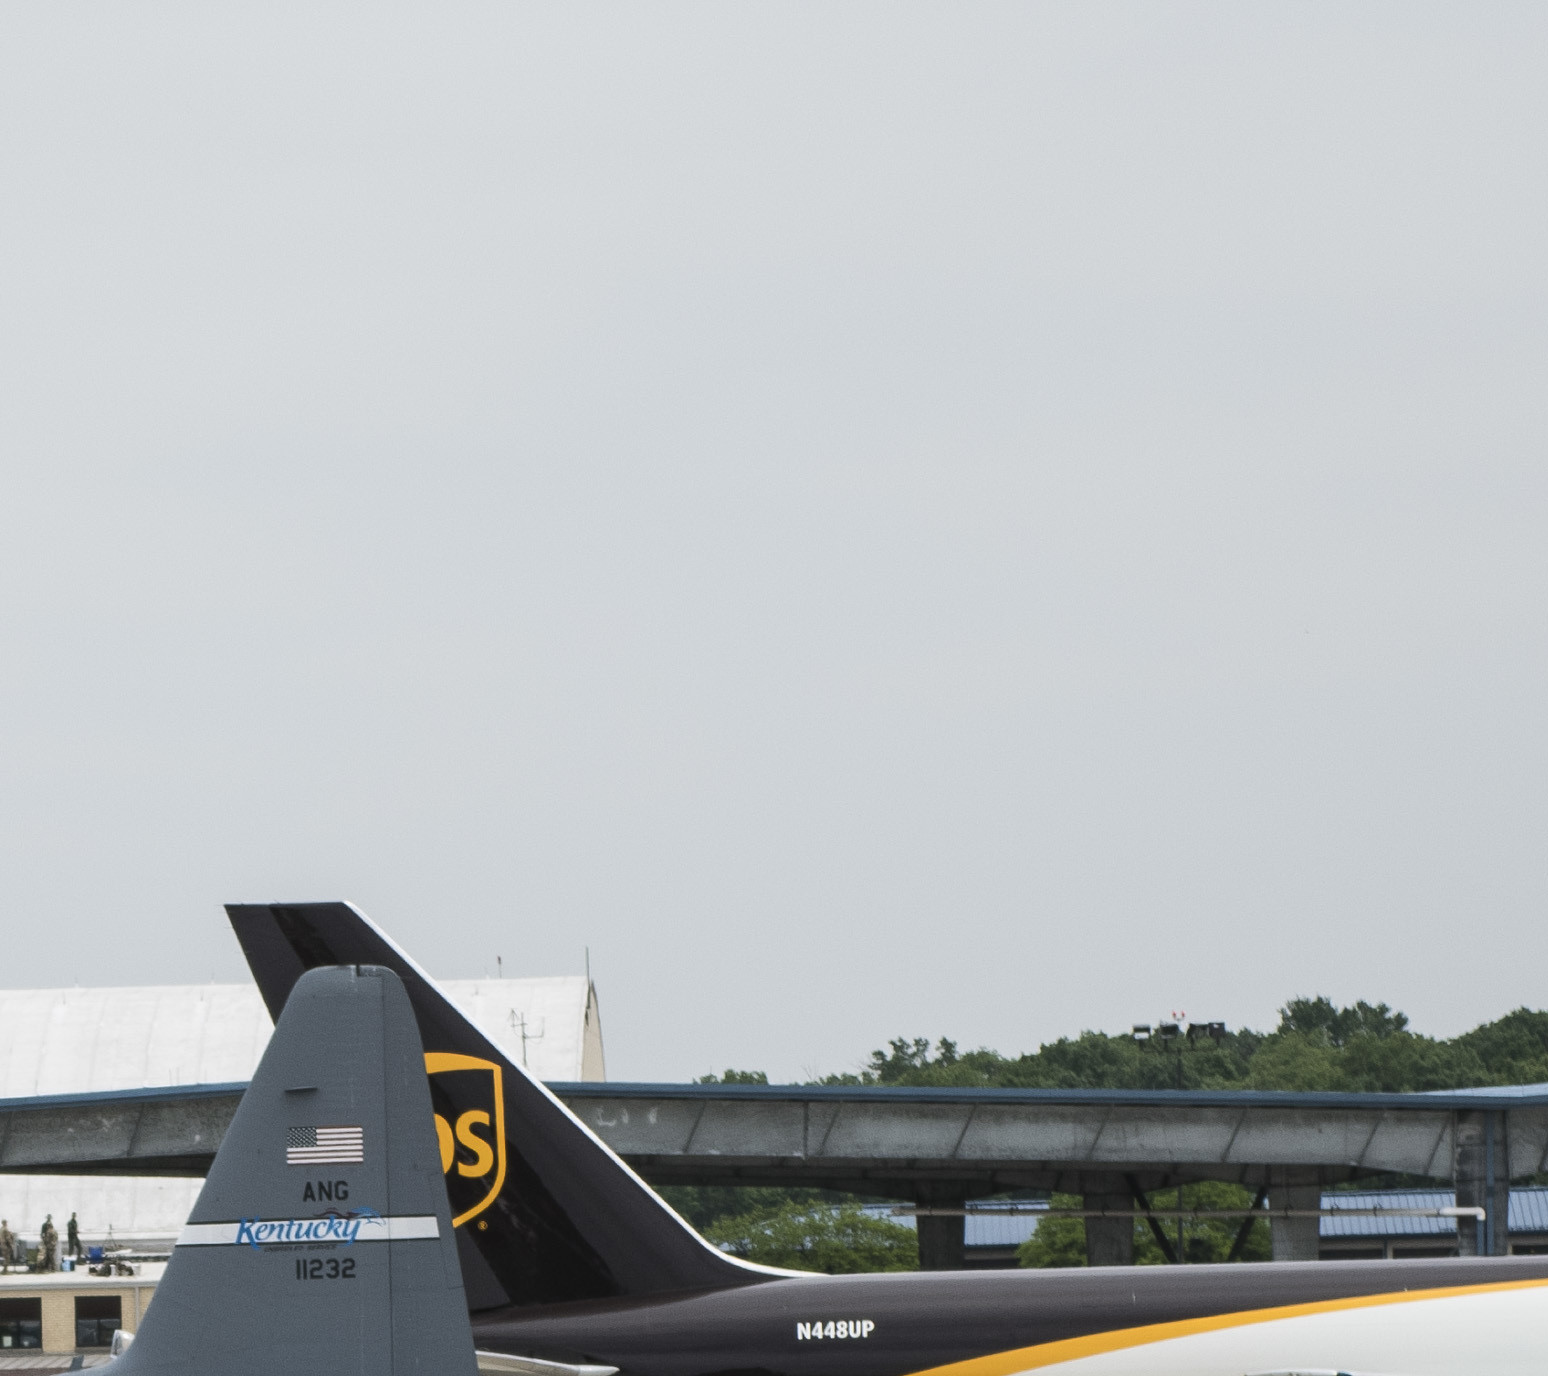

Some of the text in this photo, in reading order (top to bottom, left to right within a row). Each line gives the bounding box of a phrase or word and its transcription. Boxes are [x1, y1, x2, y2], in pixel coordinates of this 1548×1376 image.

[303, 1181, 349, 1202] ANG
[235, 1215, 362, 1250] Kentucky
[296, 1258, 357, 1280] 11232
[797, 1320, 875, 1340] N448UP
